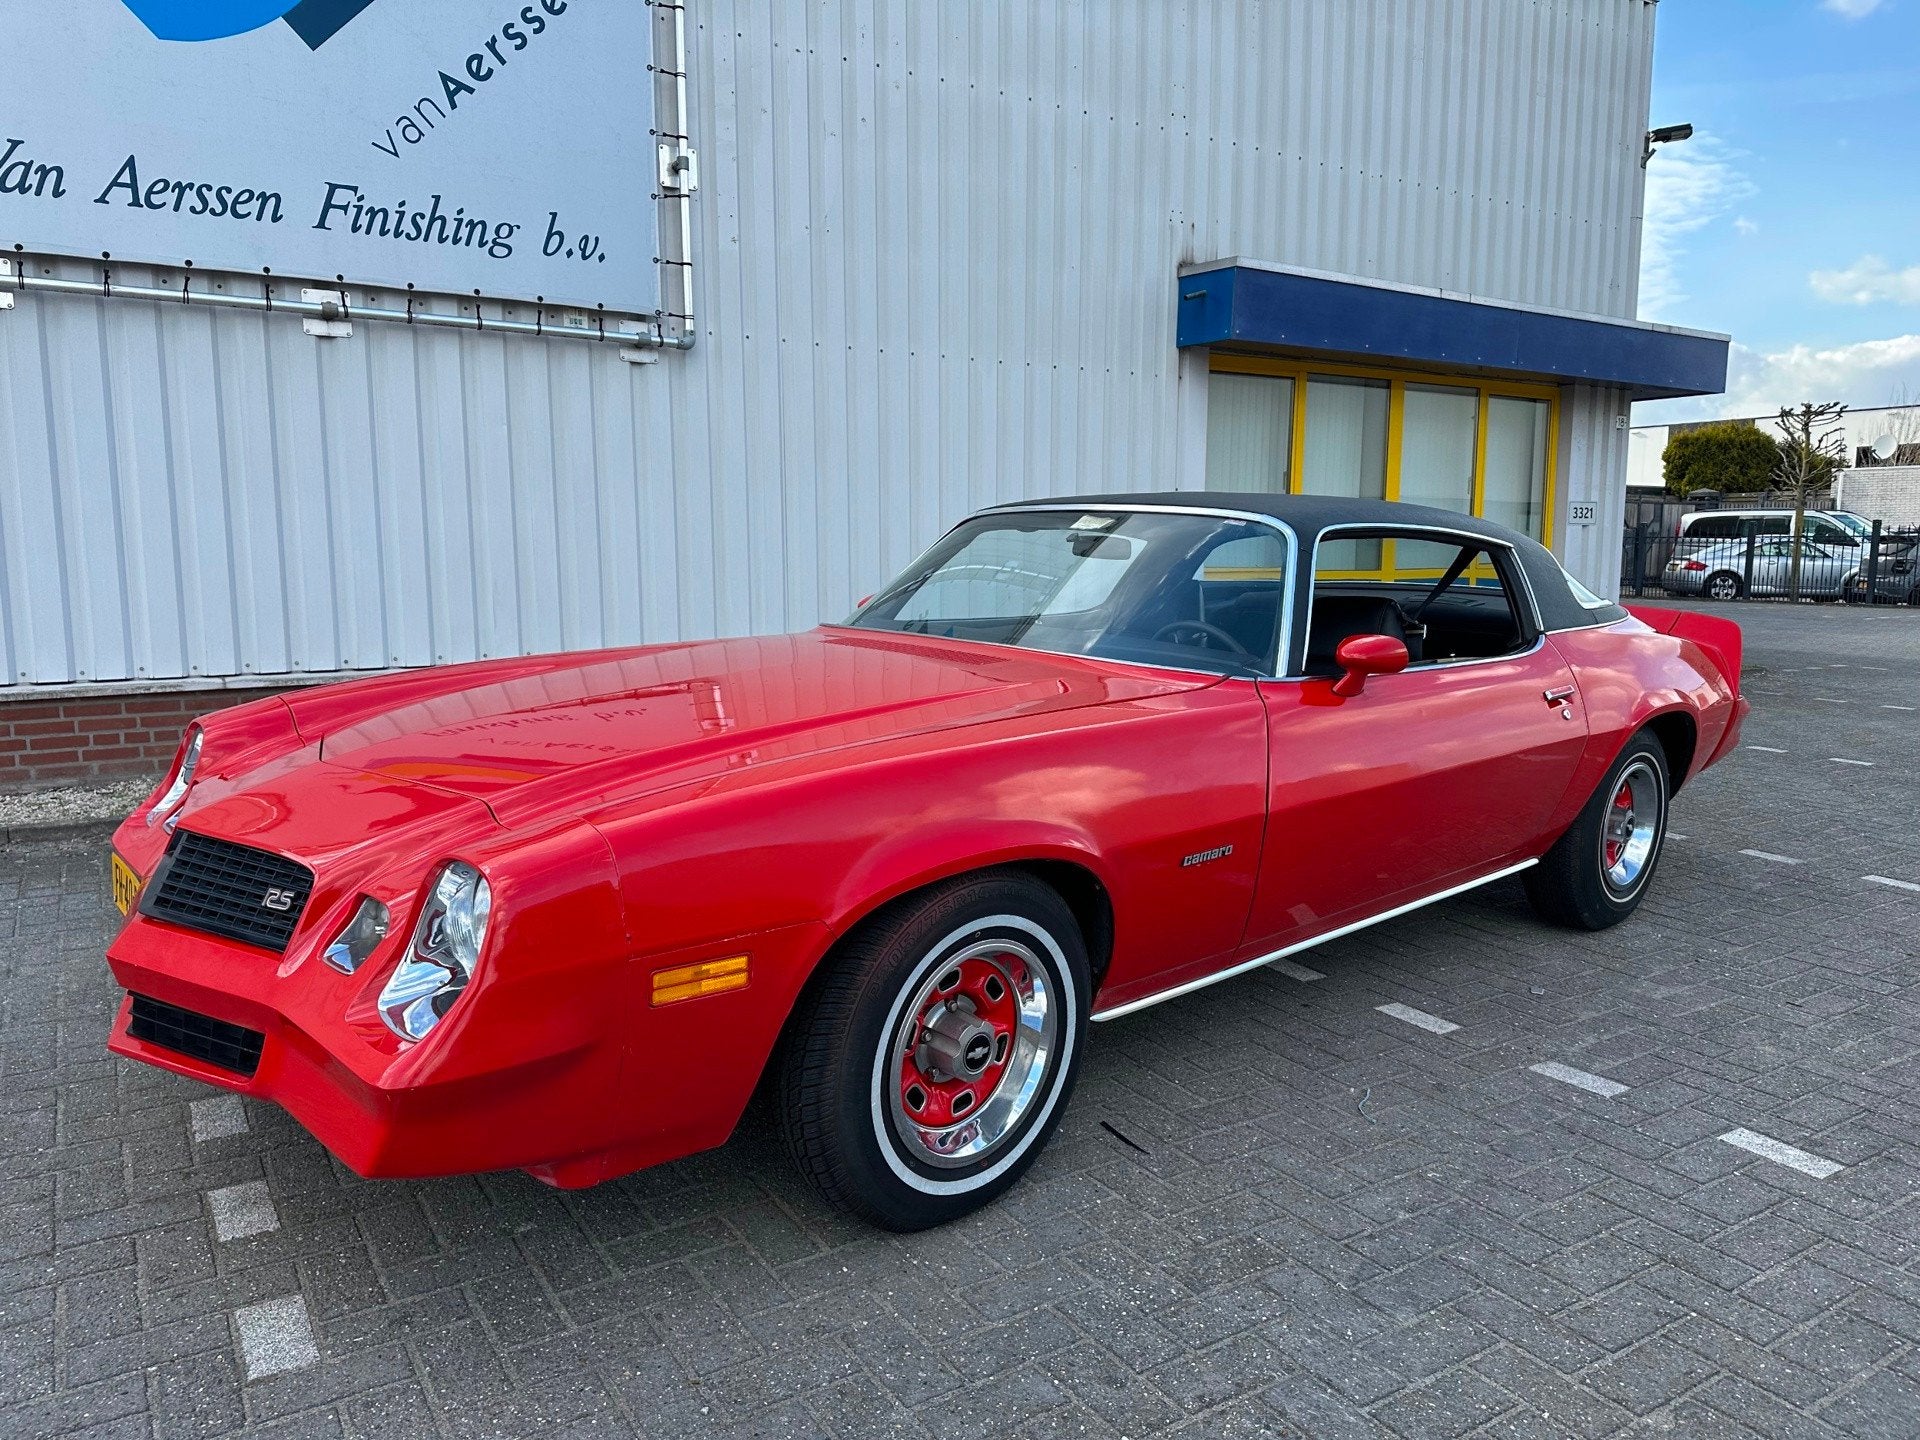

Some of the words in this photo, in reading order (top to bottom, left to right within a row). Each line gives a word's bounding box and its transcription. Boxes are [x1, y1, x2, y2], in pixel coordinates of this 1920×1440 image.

[93, 154, 284, 224] Aerssen
[312, 181, 521, 259] Finishing
[542, 211, 606, 263] b.v.
[1573, 506, 1594, 519] 3321
[261, 887, 295, 911] RS
